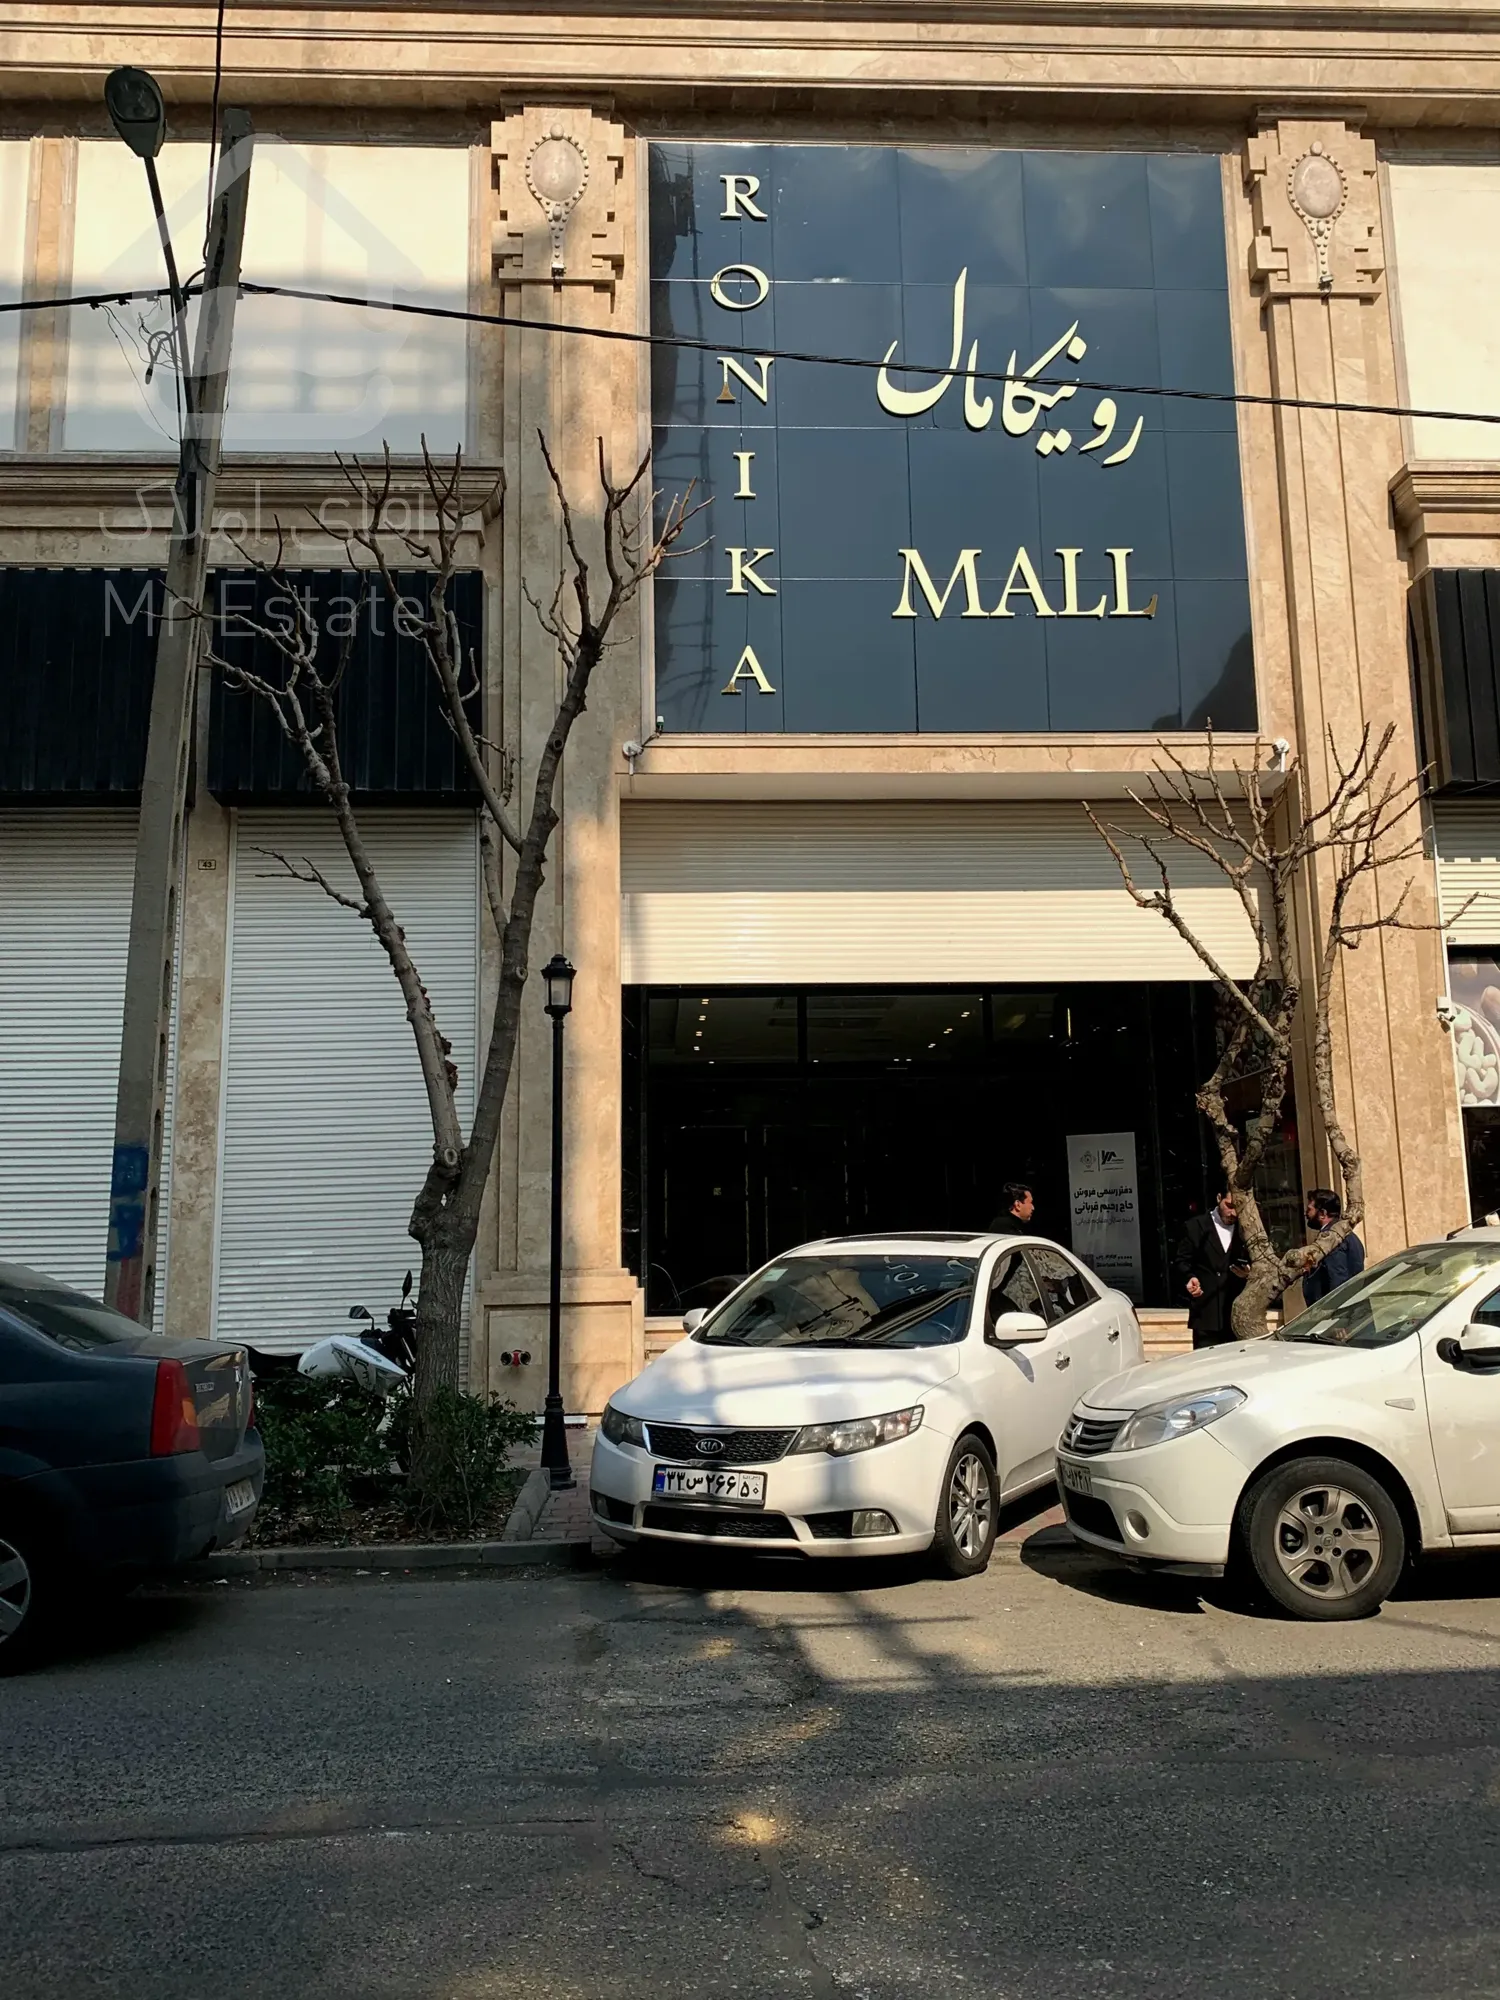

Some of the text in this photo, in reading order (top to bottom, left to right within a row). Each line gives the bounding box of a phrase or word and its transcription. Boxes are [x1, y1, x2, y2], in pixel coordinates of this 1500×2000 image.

[710, 174, 777, 694] RONIKA
[891, 546, 1157, 618] MALL
[1073, 1185, 1133, 1199] دفتر رسمی فروش
[1074, 1200, 1134, 1215] حاج رحیم قربانی
[700, 1441, 718, 1451] KIA
